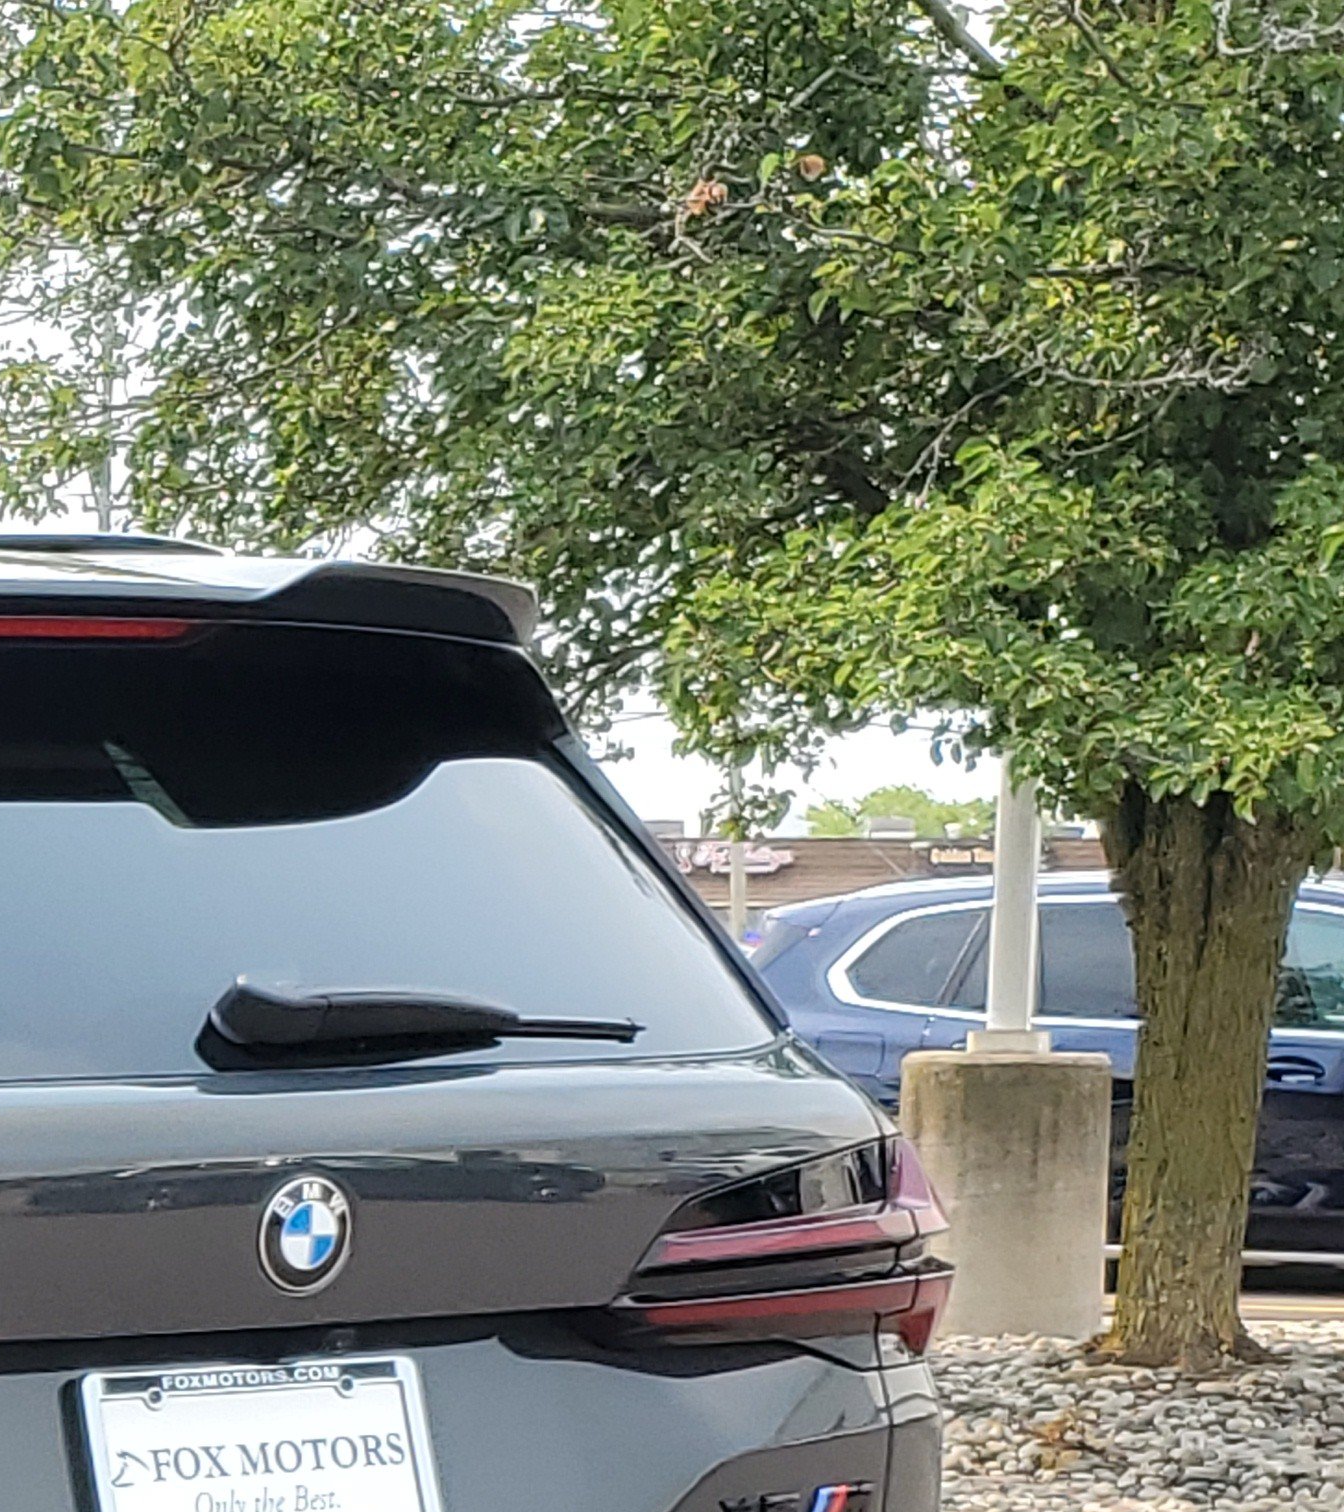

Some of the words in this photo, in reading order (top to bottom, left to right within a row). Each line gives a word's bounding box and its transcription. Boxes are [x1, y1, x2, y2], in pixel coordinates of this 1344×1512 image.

[273, 1182, 348, 1219] BMW
[161, 1365, 341, 1390] FOXMOTORS.COM
[149, 1446, 231, 1482] FOX
[235, 1432, 406, 1476] MOTORS
[294, 1484, 342, 1512] Best.
